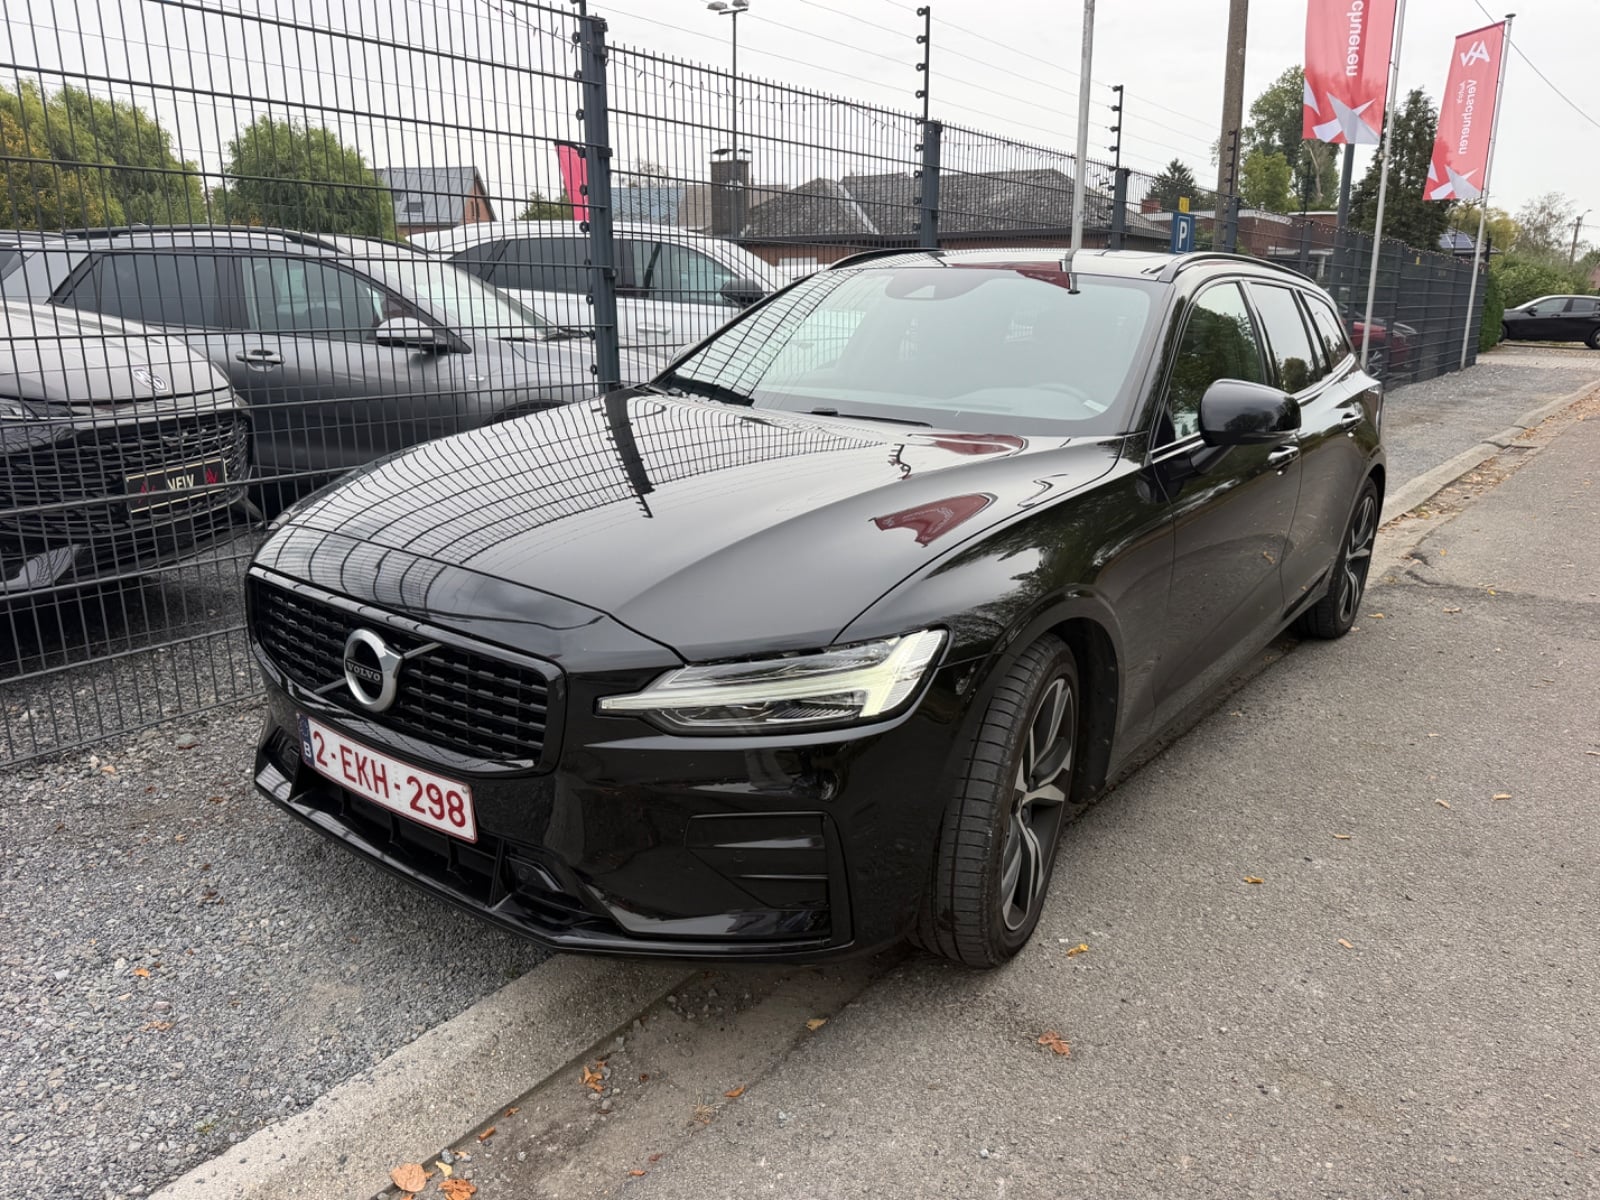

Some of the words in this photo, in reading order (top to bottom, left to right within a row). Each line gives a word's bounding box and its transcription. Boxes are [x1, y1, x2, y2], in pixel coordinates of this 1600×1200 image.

[1178, 221, 1188, 249] P
[346, 661, 381, 681] VOLVO
[302, 741, 312, 758] B
[313, 730, 466, 828] 2-EKH-298
